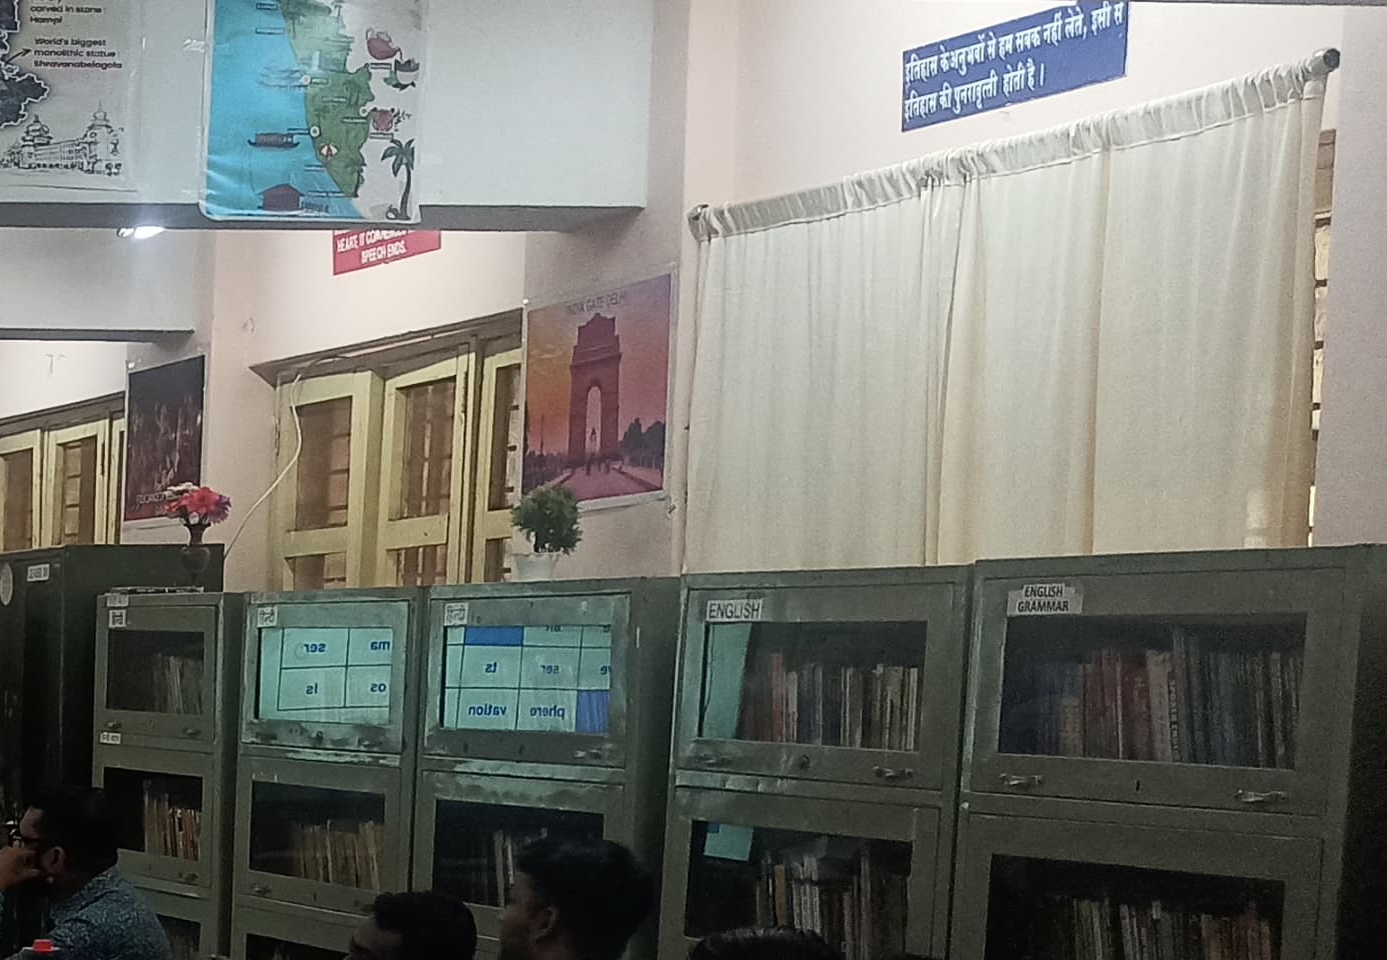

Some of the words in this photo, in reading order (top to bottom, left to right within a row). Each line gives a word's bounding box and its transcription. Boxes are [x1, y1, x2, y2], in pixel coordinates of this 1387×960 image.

[998, 33, 1013, 60] हम
[1015, 26, 1041, 53] सबक
[1043, 11, 1062, 46] नहीं
[939, 82, 952, 109] की
[361, 245, 386, 264] SPEECH
[1024, 586, 1064, 598] ENGLISH
[708, 602, 761, 619] ENGLISH
[1017, 600, 1069, 613] GRAMMAR
